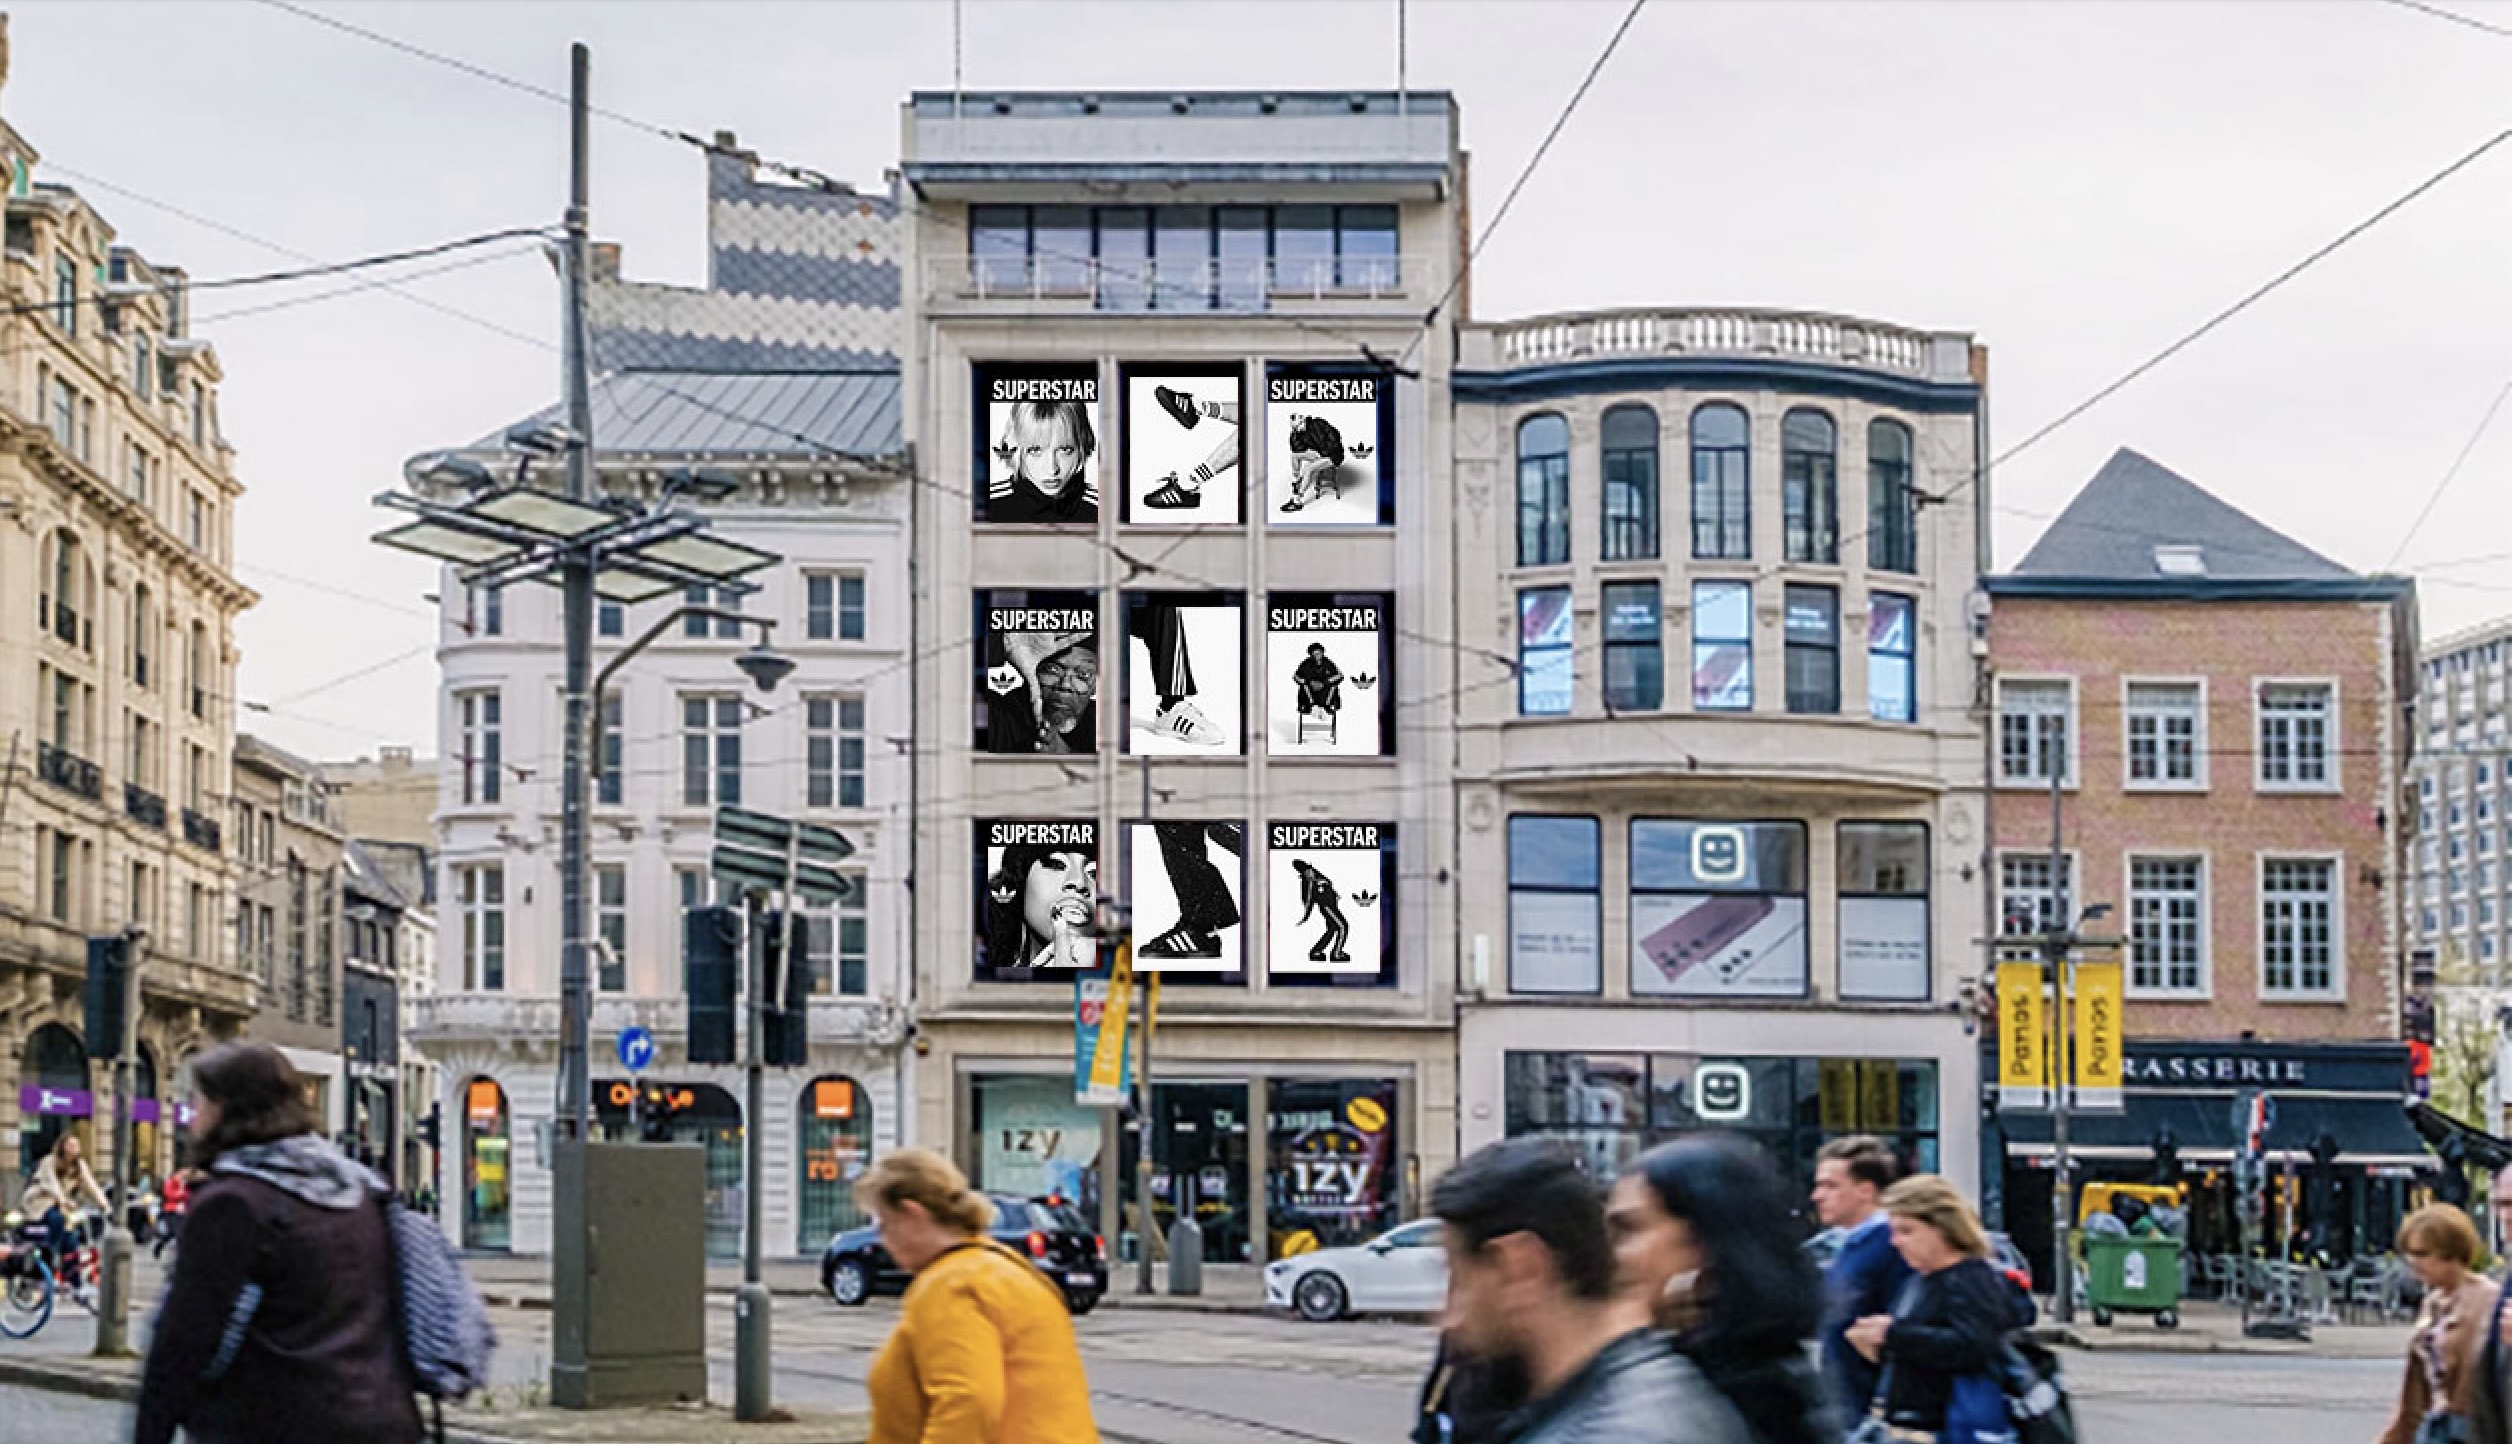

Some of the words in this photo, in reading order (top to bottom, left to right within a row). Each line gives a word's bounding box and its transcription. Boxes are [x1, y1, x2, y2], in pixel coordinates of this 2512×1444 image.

[993, 379, 1096, 399] SUPERSTAR
[1271, 379, 1374, 399] SUPERSTAR
[991, 610, 1094, 629] SUPERSTAR
[1271, 609, 1377, 629] SUPERSTAR
[991, 824, 1093, 843] SUPERSTAR
[1273, 826, 1378, 846] SUPERSTAR
[2010, 994, 2032, 1077] Panos
[2087, 995, 2109, 1077] Panos
[2121, 1057, 2305, 1080] RASSERIE
